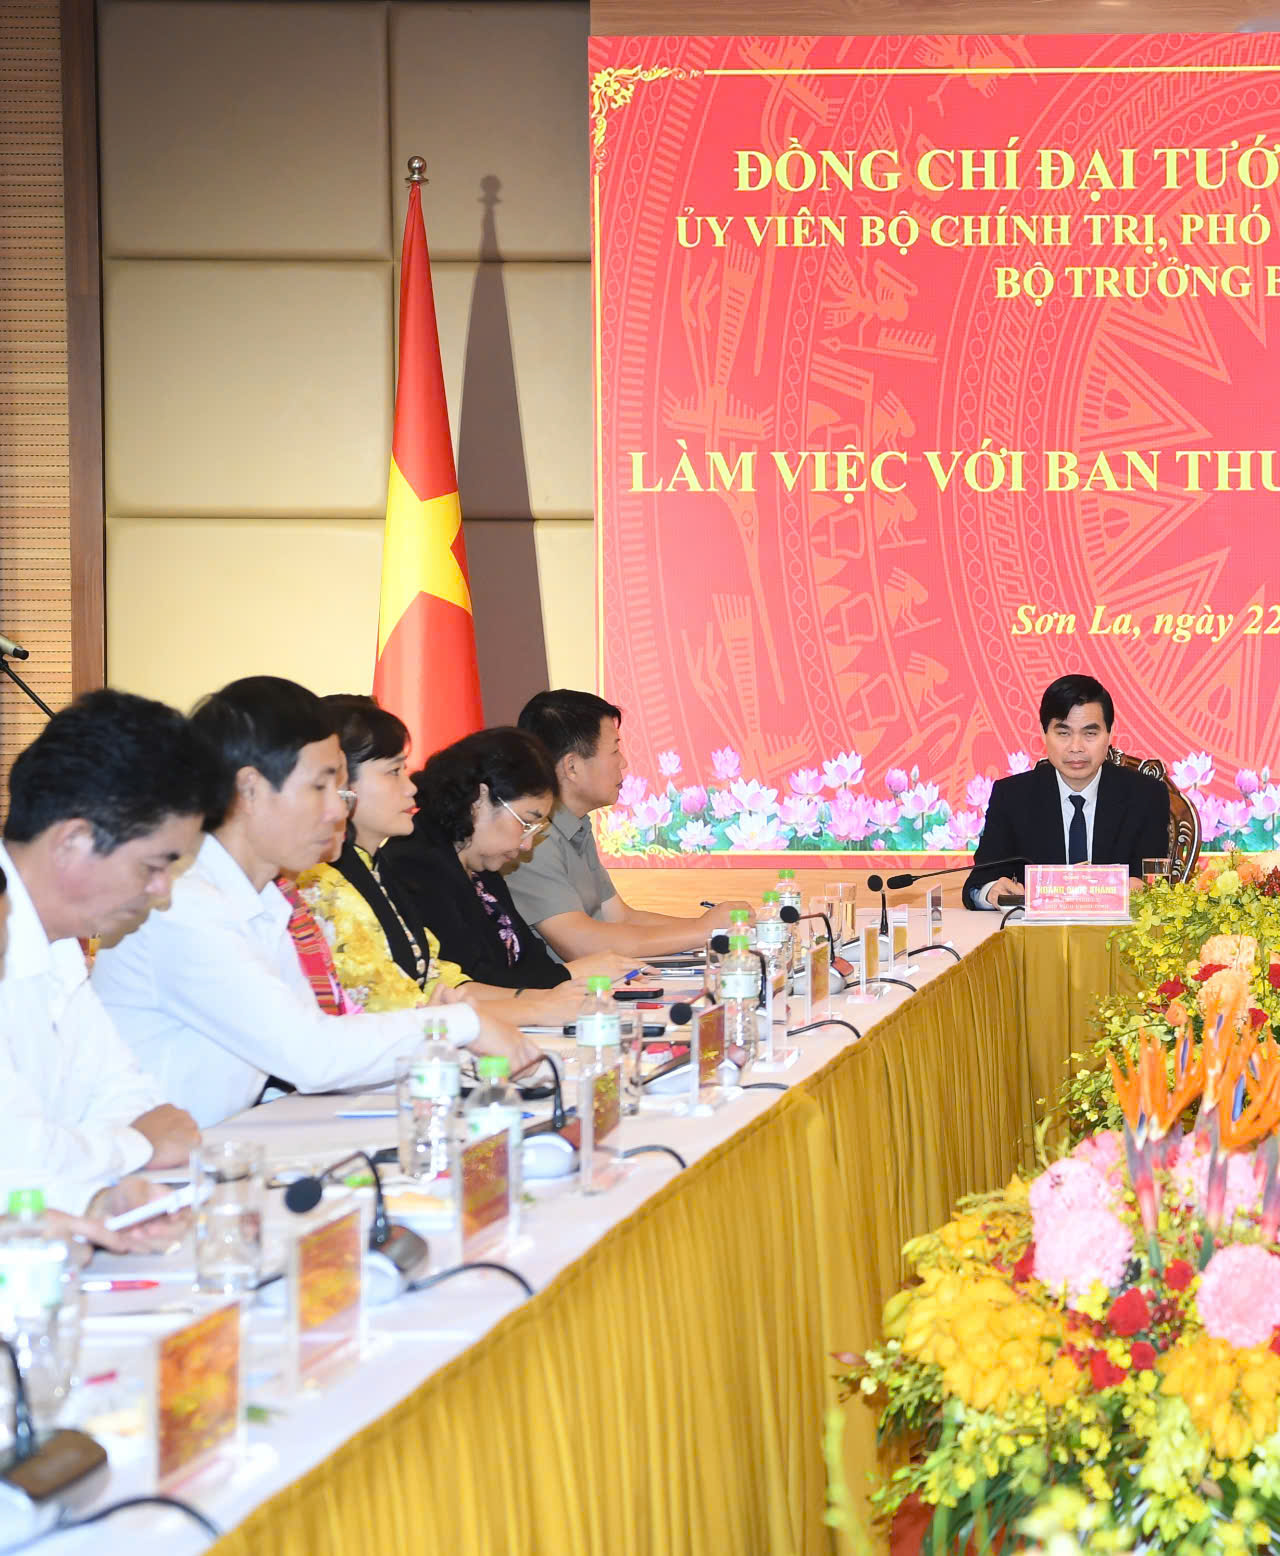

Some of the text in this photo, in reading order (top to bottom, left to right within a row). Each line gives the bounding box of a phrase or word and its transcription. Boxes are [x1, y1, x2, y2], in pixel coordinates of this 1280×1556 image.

[733, 137, 901, 192] ĐỒNG
[917, 137, 1021, 192] CHÍ
[1035, 148, 1138, 202] ĐẠI
[677, 206, 734, 247] ỦY
[745, 208, 846, 247] VIÊN
[860, 209, 919, 255] BỘ
[930, 206, 1070, 247] CHÍNH
[1083, 214, 1168, 253] TRỊ,
[1180, 203, 1271, 246] PHÓ
[995, 262, 1055, 307] BỘ
[1065, 256, 1253, 298] TRƯỞNG
[627, 438, 757, 493] LÀM
[770, 444, 907, 504] VIỆC
[923, 438, 1027, 493] VỚI
[1043, 450, 1161, 492] BAN
[1010, 604, 1076, 635] Sơn
[1087, 605, 1141, 641] La,
[1153, 604, 1234, 643] ngày
